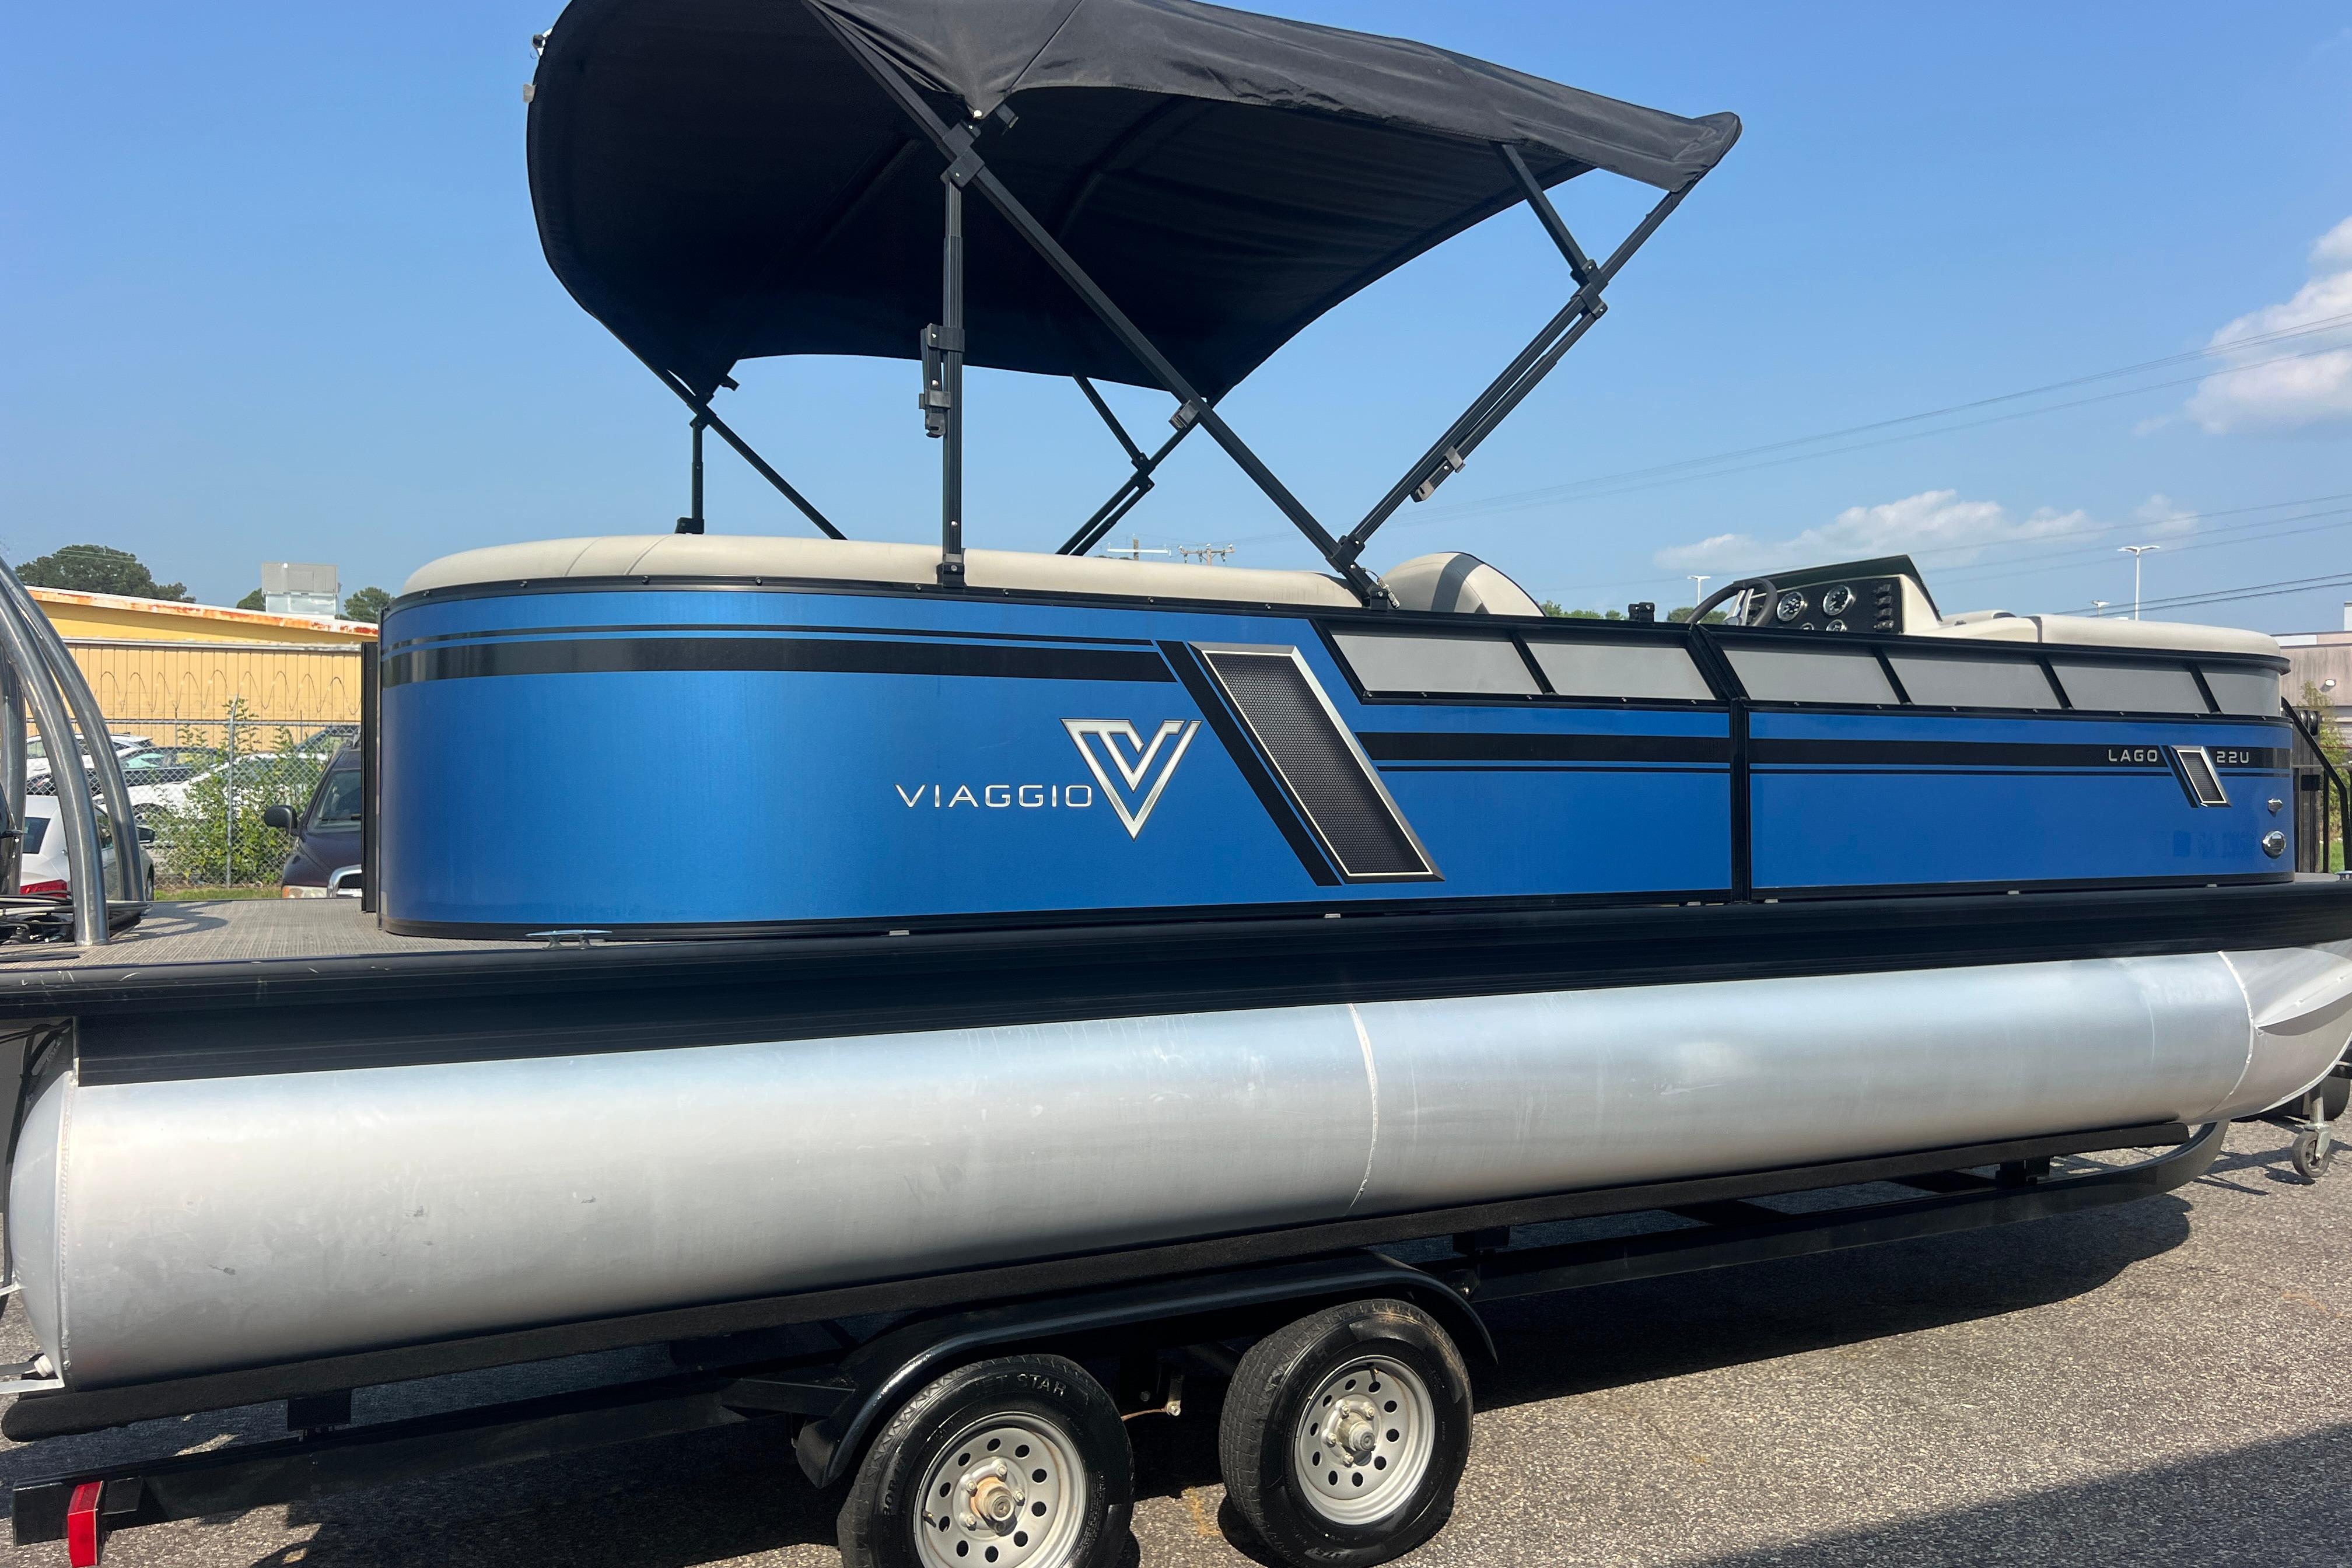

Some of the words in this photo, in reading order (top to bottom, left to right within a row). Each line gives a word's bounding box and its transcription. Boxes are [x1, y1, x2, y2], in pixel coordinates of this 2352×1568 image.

[2108, 749, 2158, 762] LAGO
[2217, 751, 2249, 764] 22U
[895, 785, 1092, 807] VIAGGIO
[1017, 1373, 1067, 1396] STAR
